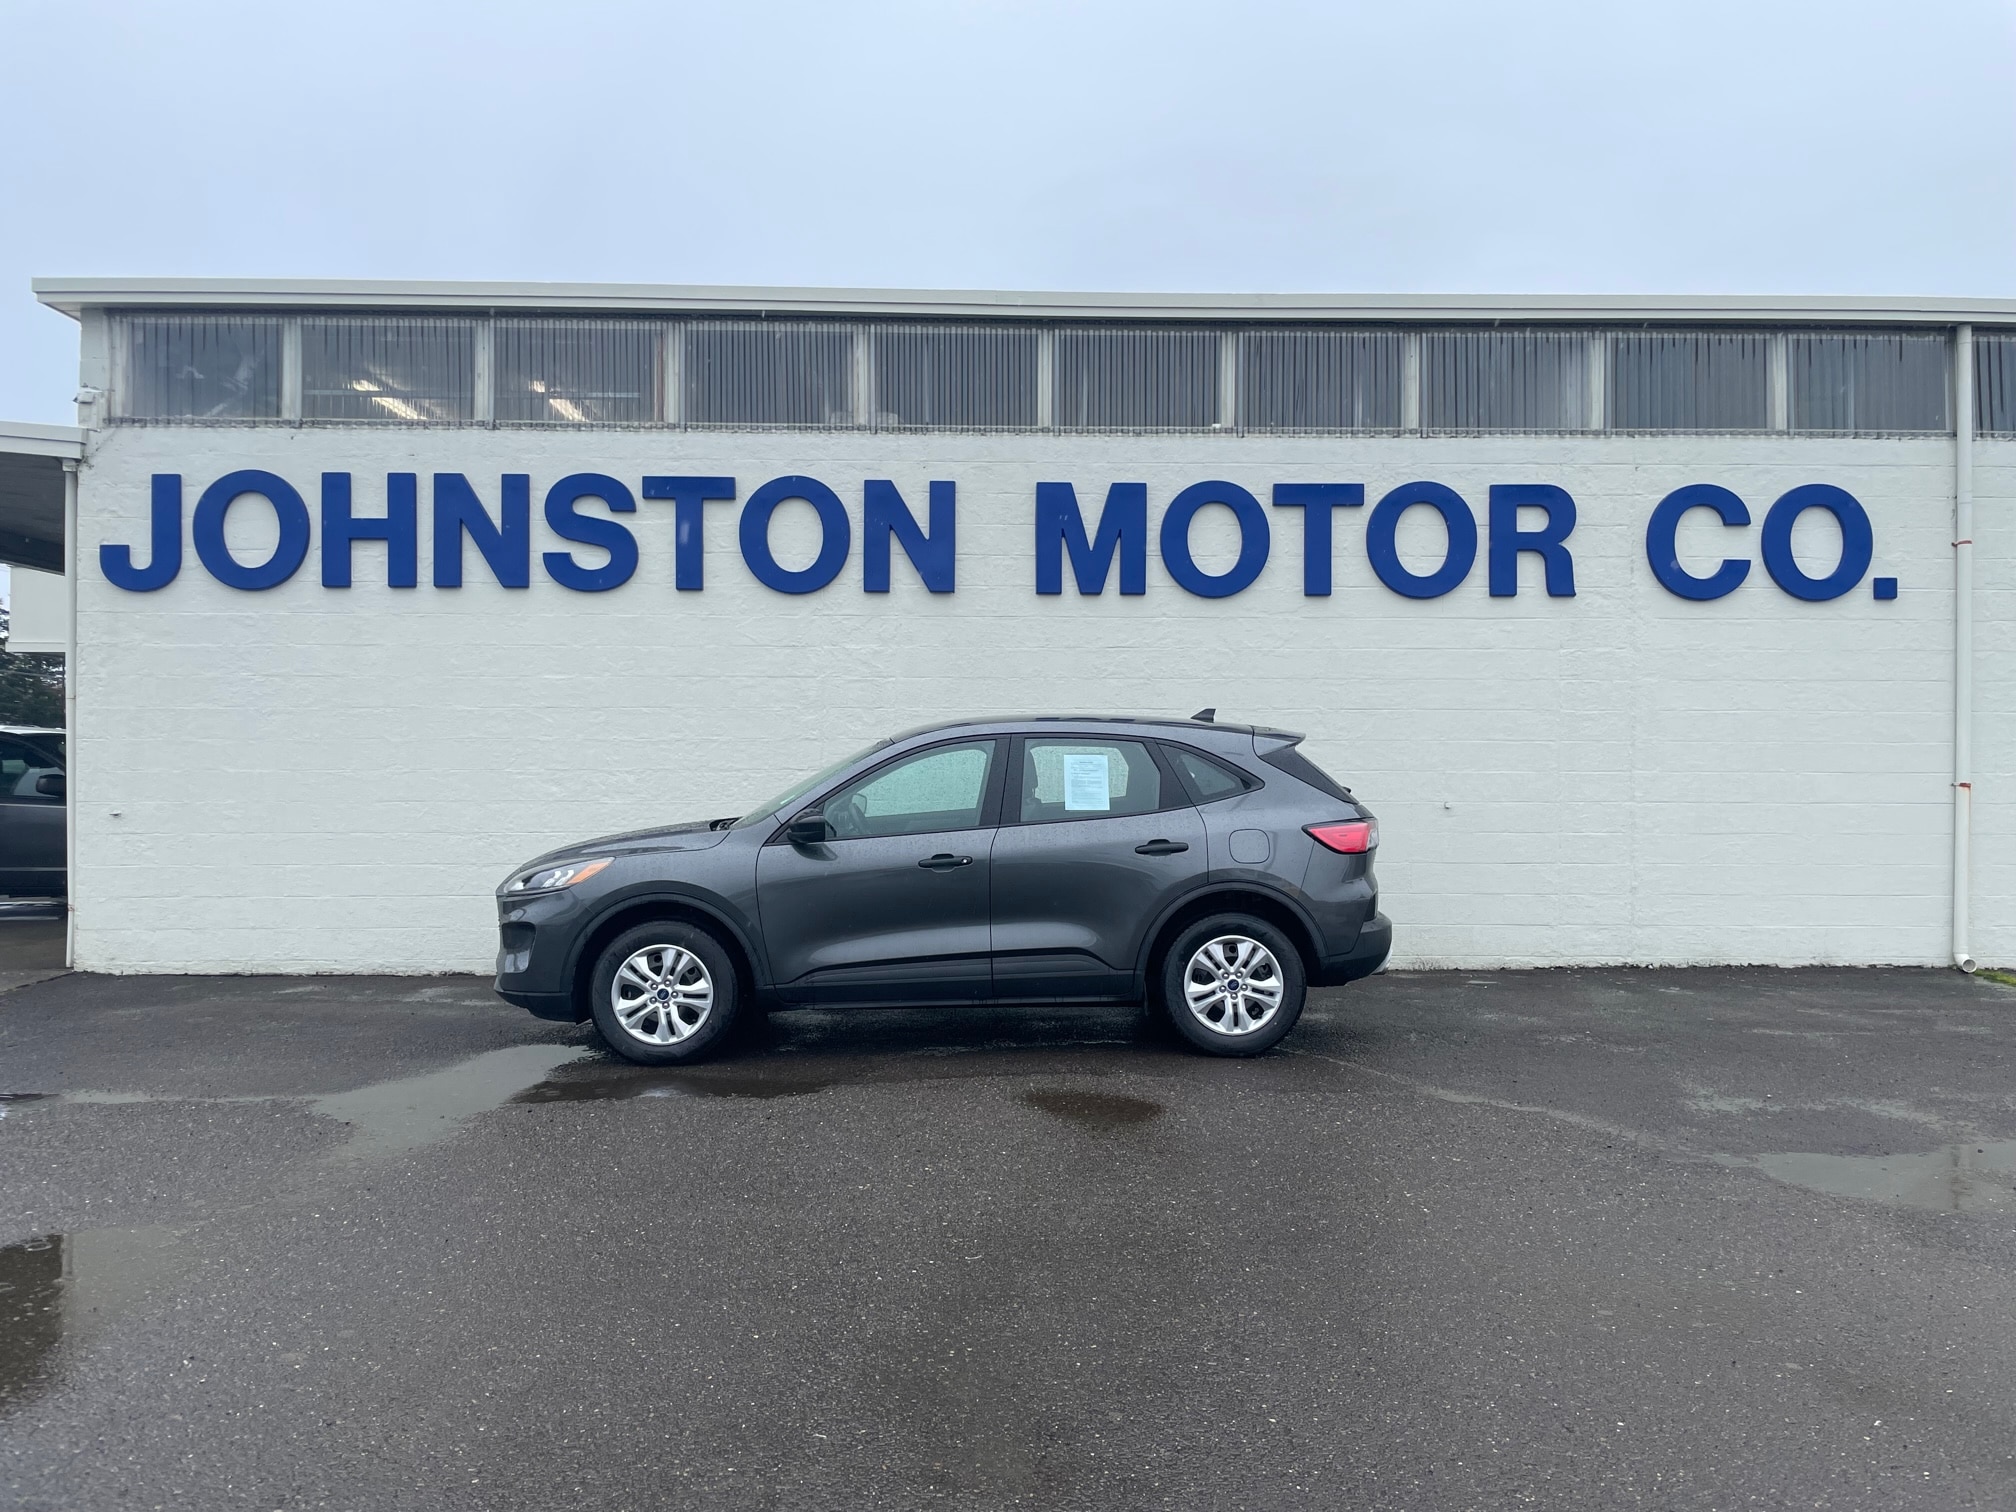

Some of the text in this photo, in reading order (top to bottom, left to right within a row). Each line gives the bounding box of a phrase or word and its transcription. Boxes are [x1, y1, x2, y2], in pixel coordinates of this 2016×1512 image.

[99, 469, 1898, 602] JOHNSTON MOTOR CO.
